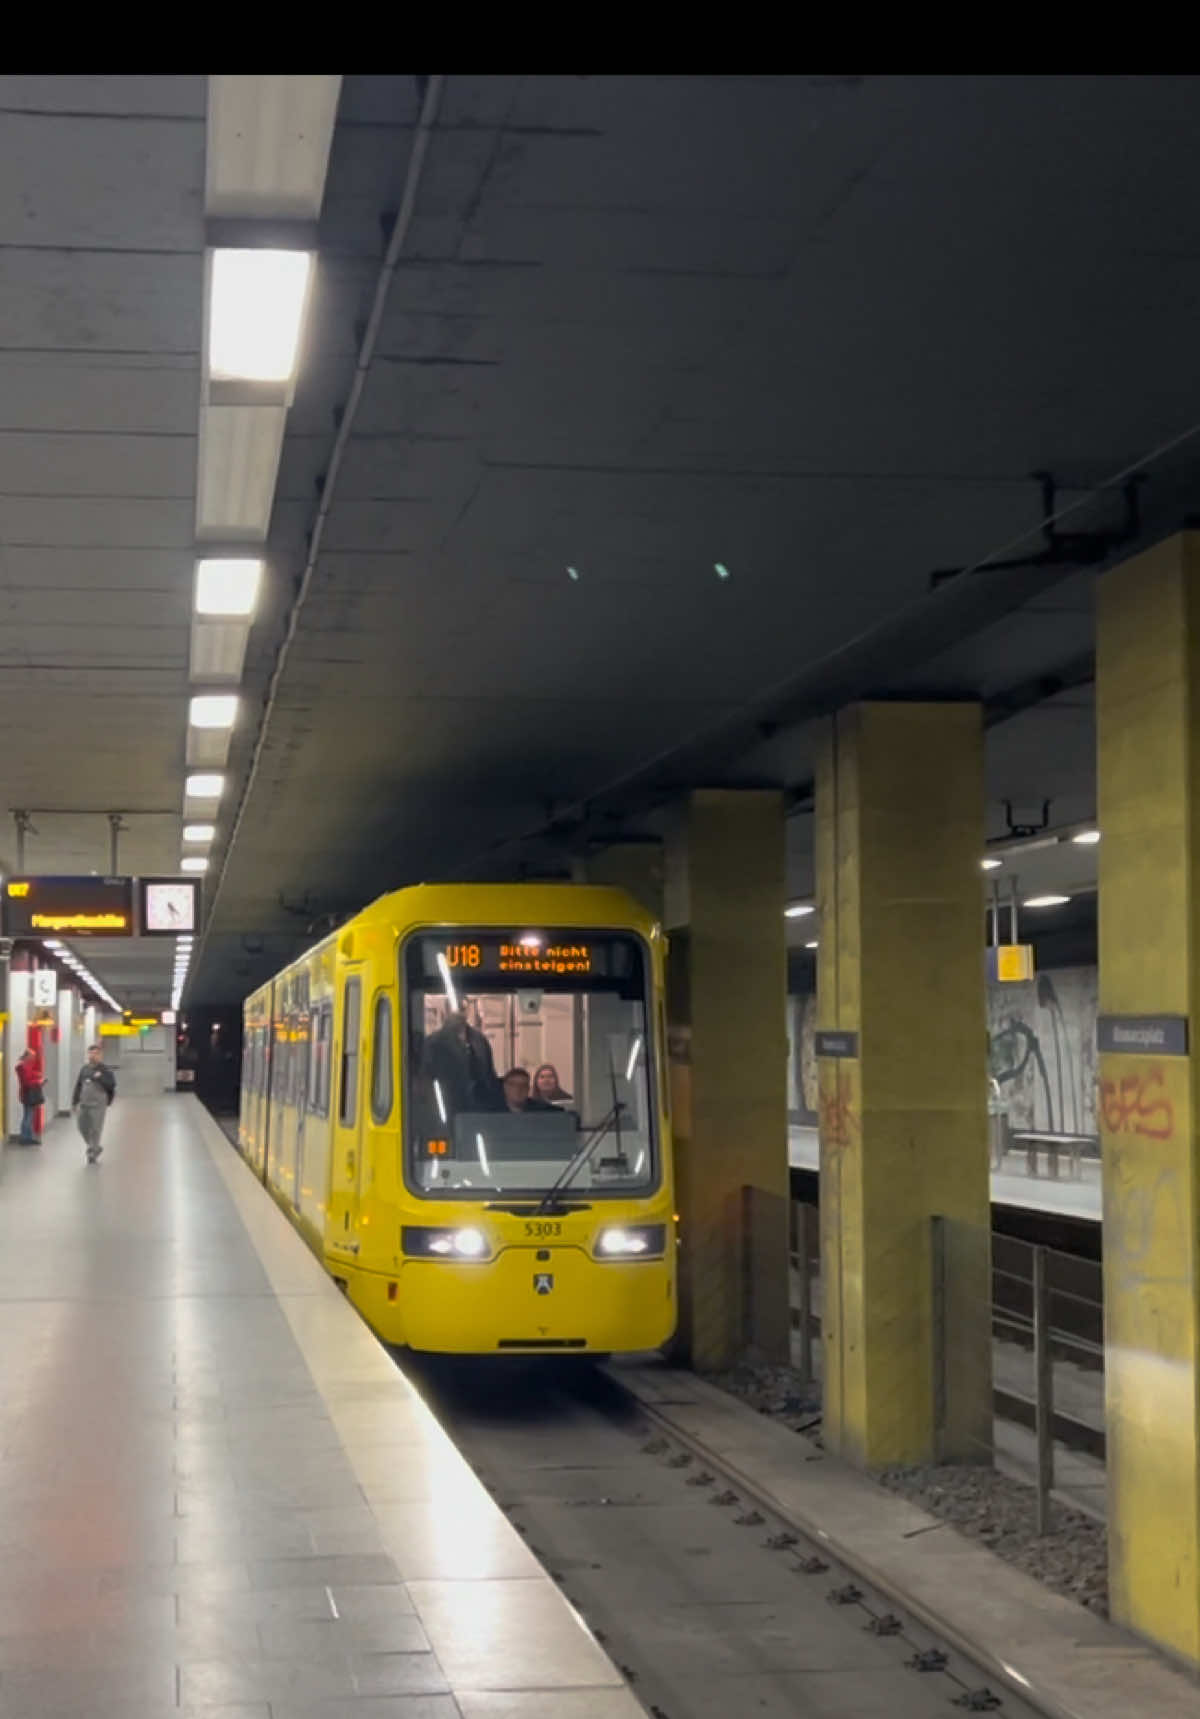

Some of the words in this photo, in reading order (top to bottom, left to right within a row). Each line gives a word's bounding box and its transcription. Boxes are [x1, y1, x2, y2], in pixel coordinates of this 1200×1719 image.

[446, 945, 481, 967] U18
[500, 945, 540, 957] Bitte
[546, 946, 588, 957] nicht
[499, 960, 591, 972] einsteigen!
[524, 1222, 562, 1236] 5303
